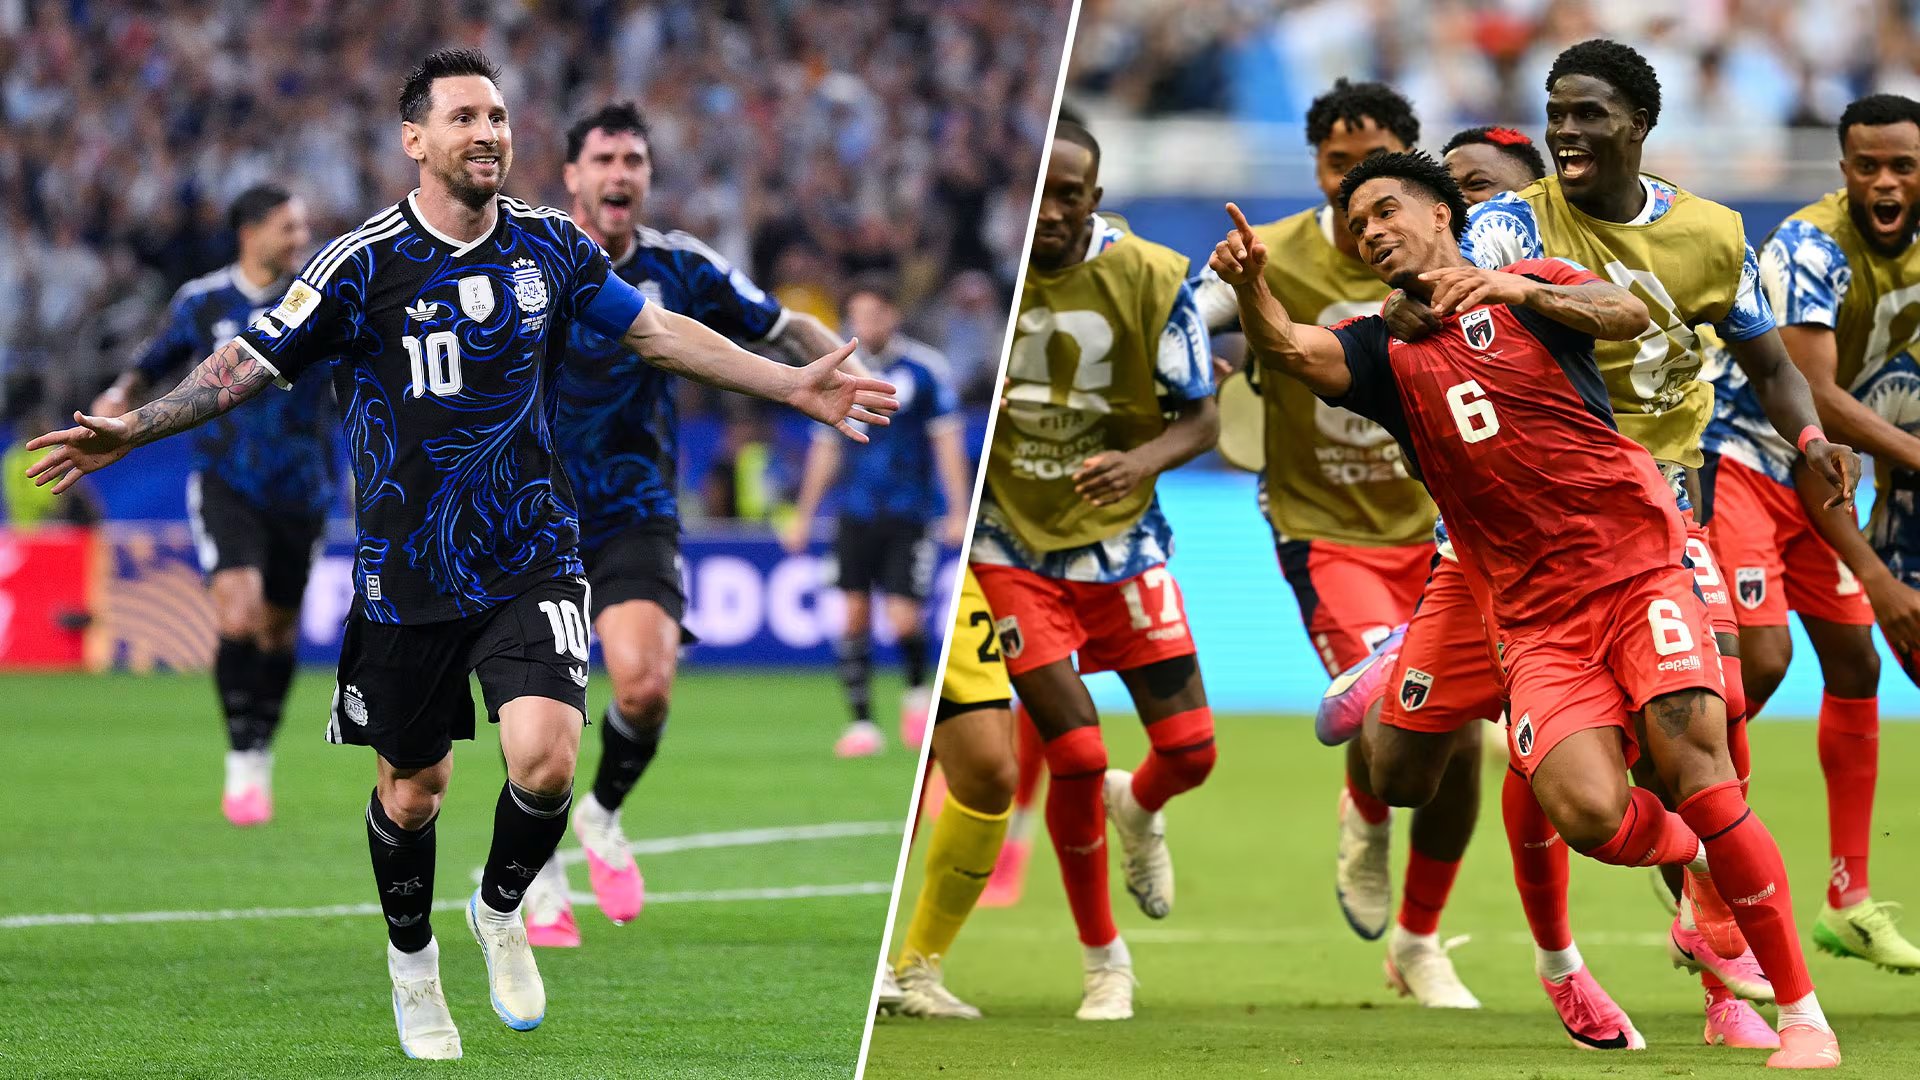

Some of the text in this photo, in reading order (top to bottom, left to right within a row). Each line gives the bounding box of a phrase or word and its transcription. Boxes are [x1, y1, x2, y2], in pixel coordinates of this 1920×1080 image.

[471, 304, 487, 312] FIFA
[1462, 310, 1488, 325] FCF
[402, 331, 463, 399] 10
[1040, 410, 1084, 430] FIFA
[1446, 379, 1501, 444] 6
[1119, 567, 1182, 629] 17
[538, 599, 589, 663] 10
[970, 611, 1000, 663] 2
[1648, 599, 1694, 656] 6
[1407, 669, 1432, 682] FCF
[1657, 655, 1701, 672] capelli
[1732, 881, 1776, 906] capelli
